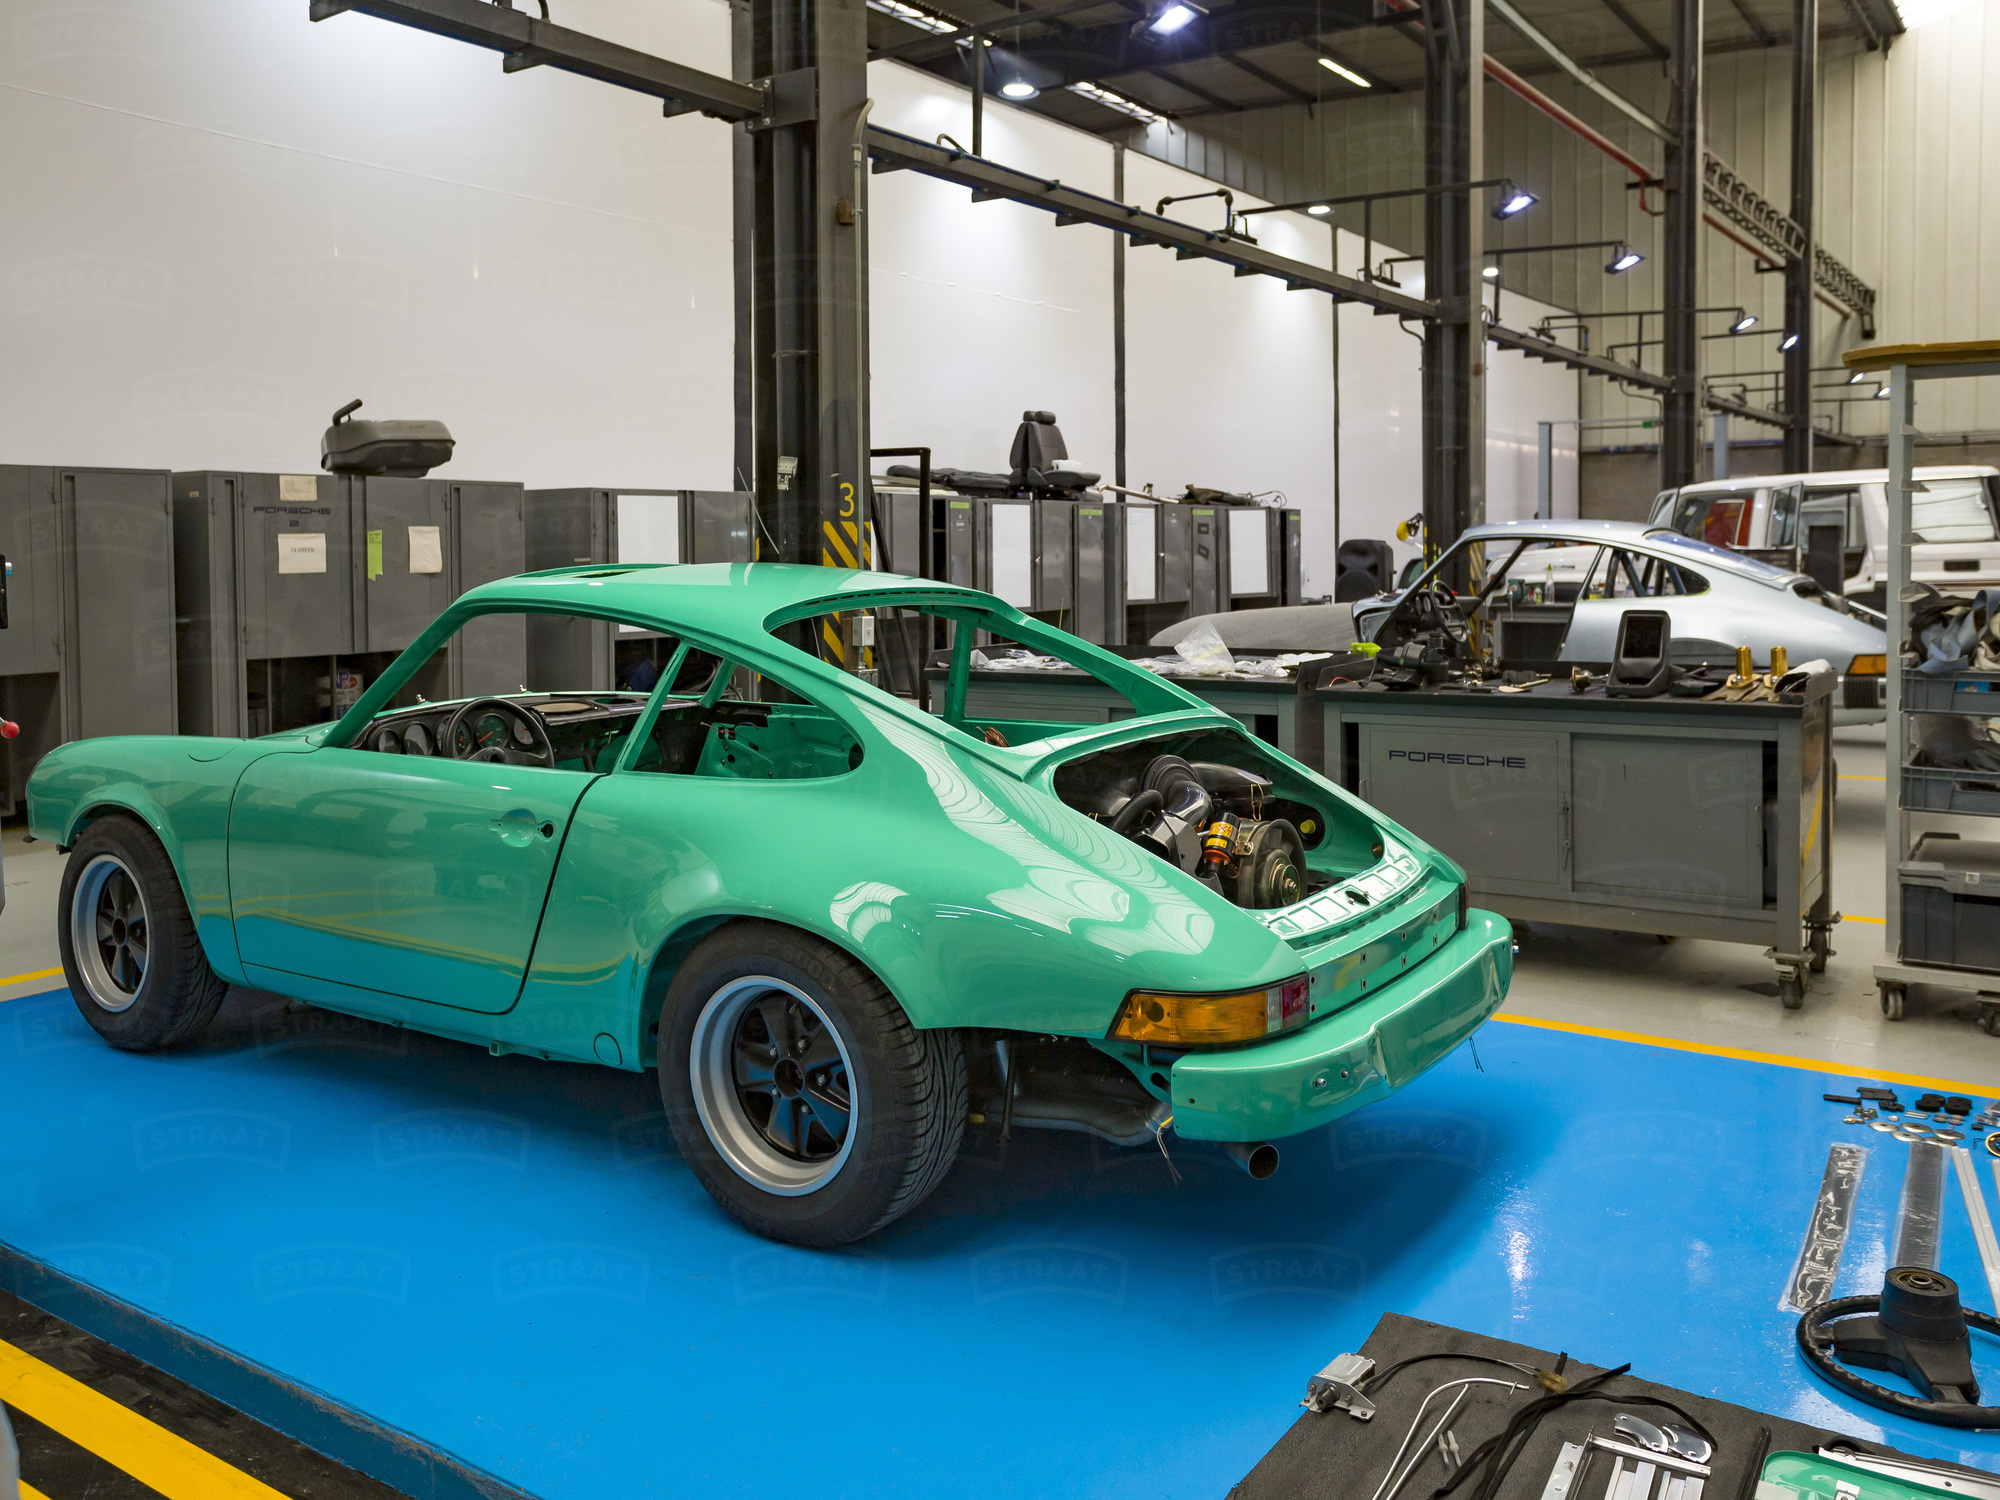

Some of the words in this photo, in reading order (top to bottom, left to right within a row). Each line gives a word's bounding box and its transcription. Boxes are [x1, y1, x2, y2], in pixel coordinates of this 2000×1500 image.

[253, 506, 331, 516] PORSCHE
[839, 482, 855, 517] 3
[1389, 750, 1526, 769] PORSCHE
[764, 937, 836, 988] P6000
